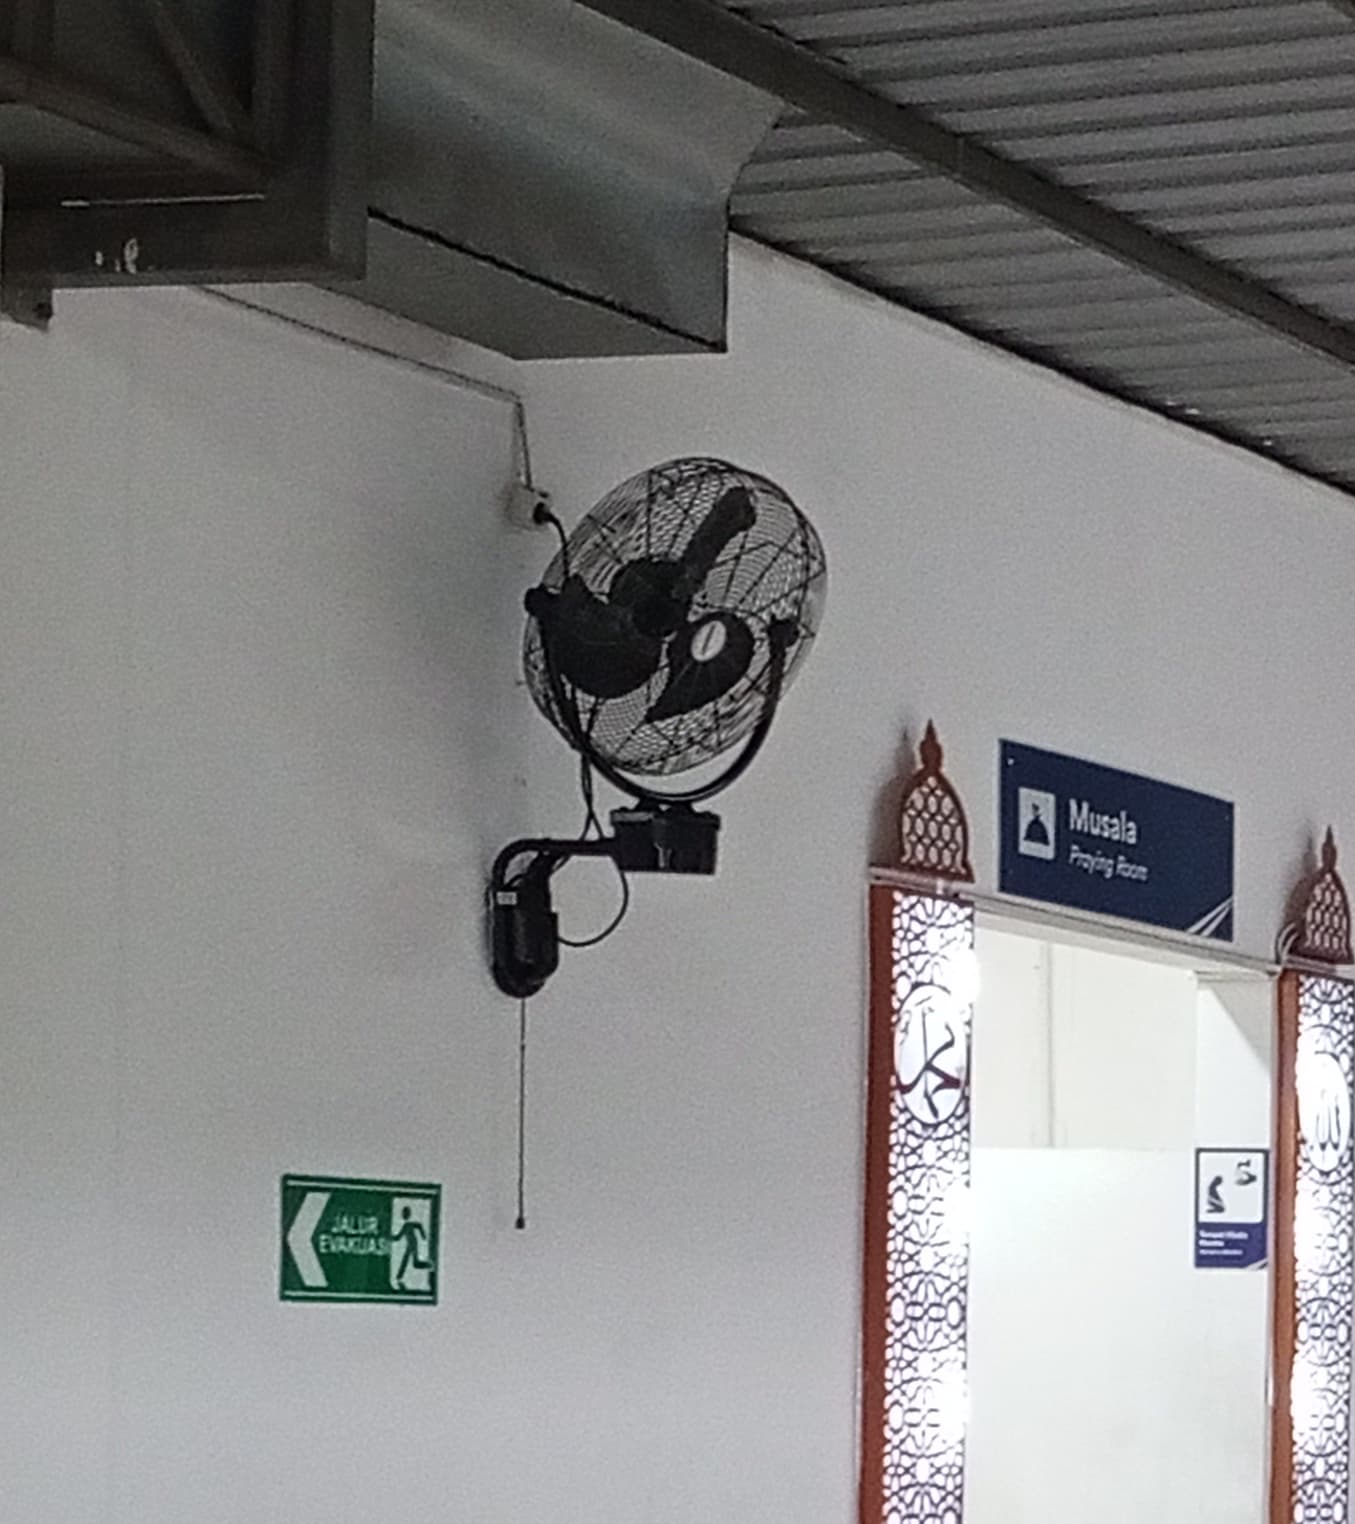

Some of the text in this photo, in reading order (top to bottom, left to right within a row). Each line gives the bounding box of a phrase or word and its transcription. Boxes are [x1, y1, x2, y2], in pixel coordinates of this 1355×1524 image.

[1069, 798, 1137, 844] Musala
[1069, 844, 1149, 881] Praying Room
[331, 1214, 379, 1235] JALUR
